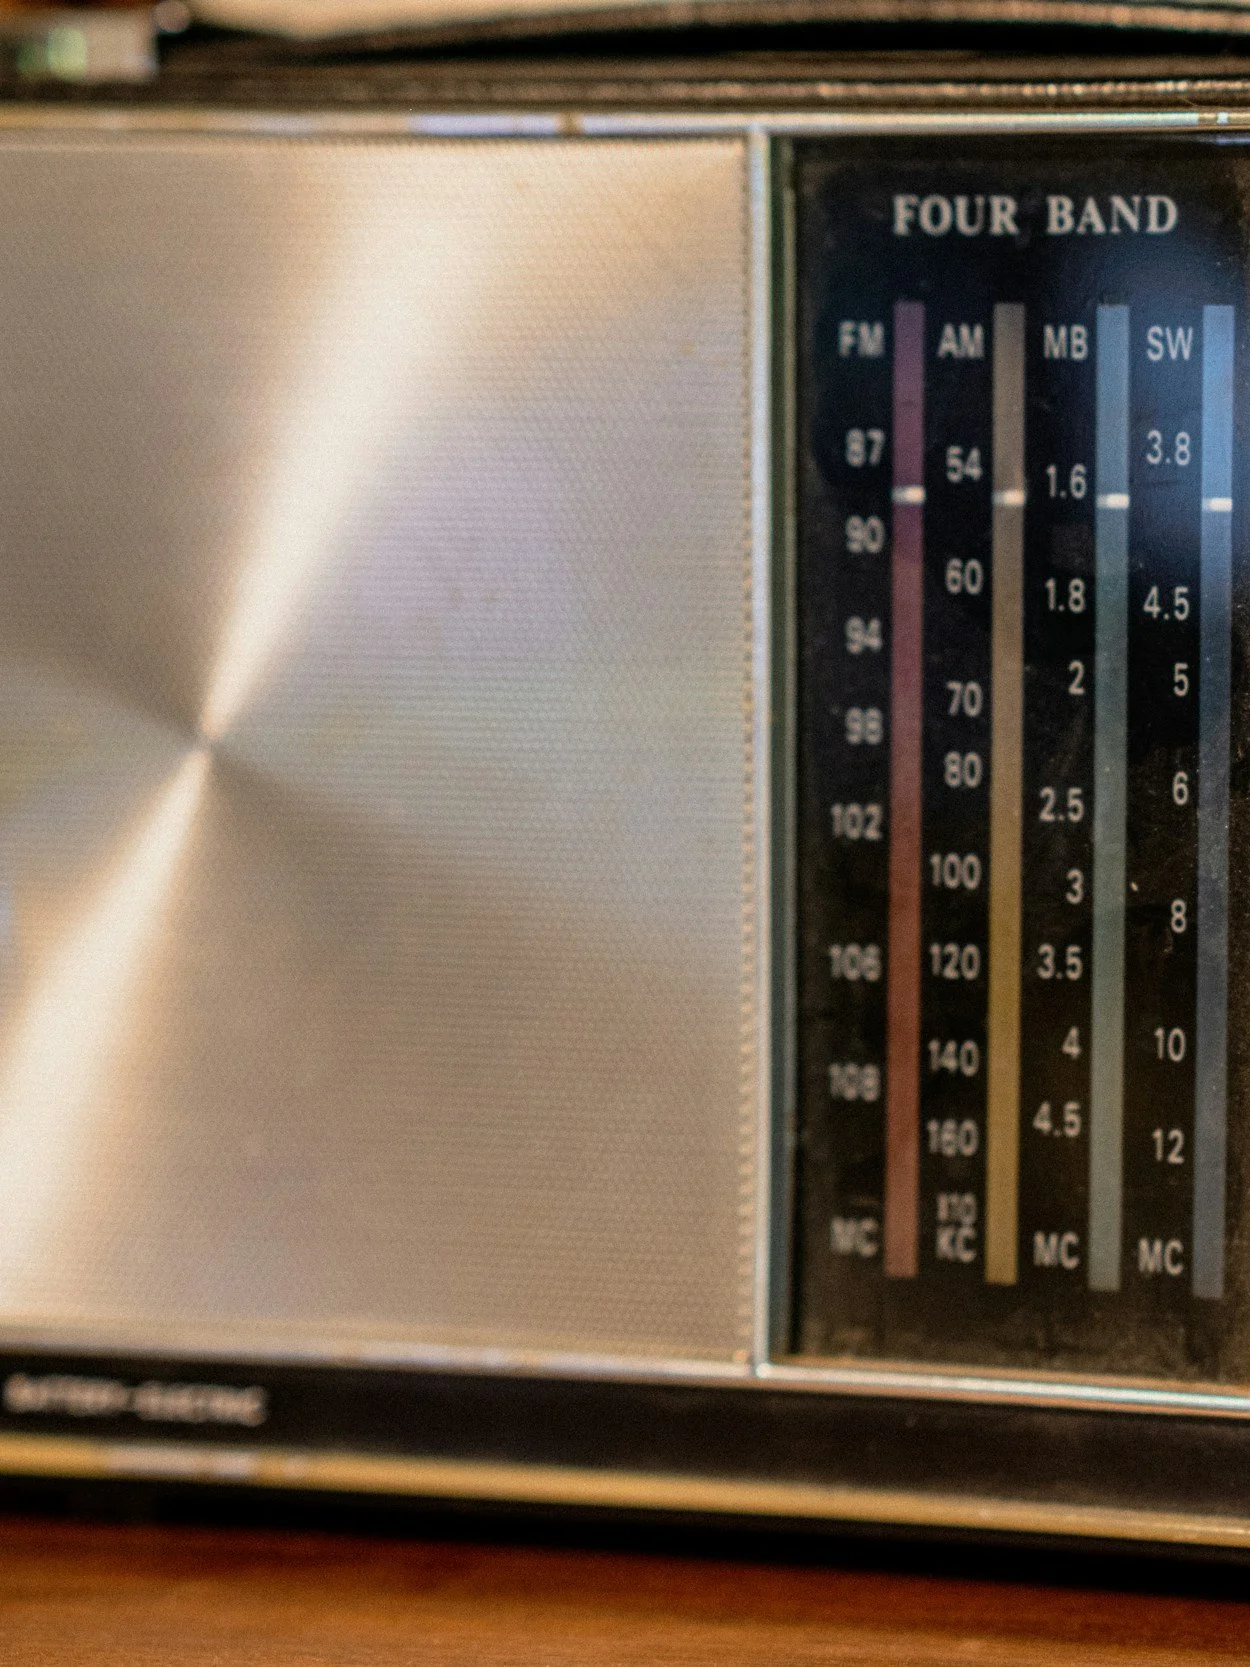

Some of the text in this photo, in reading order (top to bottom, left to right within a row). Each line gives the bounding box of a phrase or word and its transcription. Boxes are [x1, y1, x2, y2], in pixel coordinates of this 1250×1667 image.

[892, 195, 1178, 235] FOUR BAND
[838, 322, 1193, 361] FM AM MB SW
[845, 429, 885, 466] 87
[946, 446, 982, 482] 54
[1146, 430, 1190, 465] 3.8
[1046, 464, 1086, 498] 1.6
[845, 516, 885, 552] 90
[945, 559, 983, 595] 60
[1046, 579, 1085, 612] 1.8
[1143, 587, 1189, 620] 4.5
[844, 617, 882, 653] 94
[1068, 661, 1085, 695] 2
[1173, 664, 1189, 696] 5
[946, 682, 982, 717] 70
[944, 752, 982, 787] 80
[1039, 788, 1084, 822] 2.5
[1173, 772, 1189, 805] 6
[832, 804, 882, 840] 102
[930, 854, 981, 890] 100
[1067, 870, 1083, 904] 3
[1171, 900, 1187, 933] 8
[930, 944, 980, 980] 120
[1037, 945, 1083, 979] 3.5
[928, 1040, 978, 1076] 140
[1062, 1027, 1081, 1058] 4
[1154, 1028, 1186, 1062] 10
[1033, 1103, 1081, 1137] 4.5
[1152, 1130, 1184, 1164] 12
[831, 1217, 878, 1257] MC
[936, 1227, 976, 1262] KC
[1034, 1232, 1080, 1269] MC
[1138, 1239, 1183, 1275] MC
